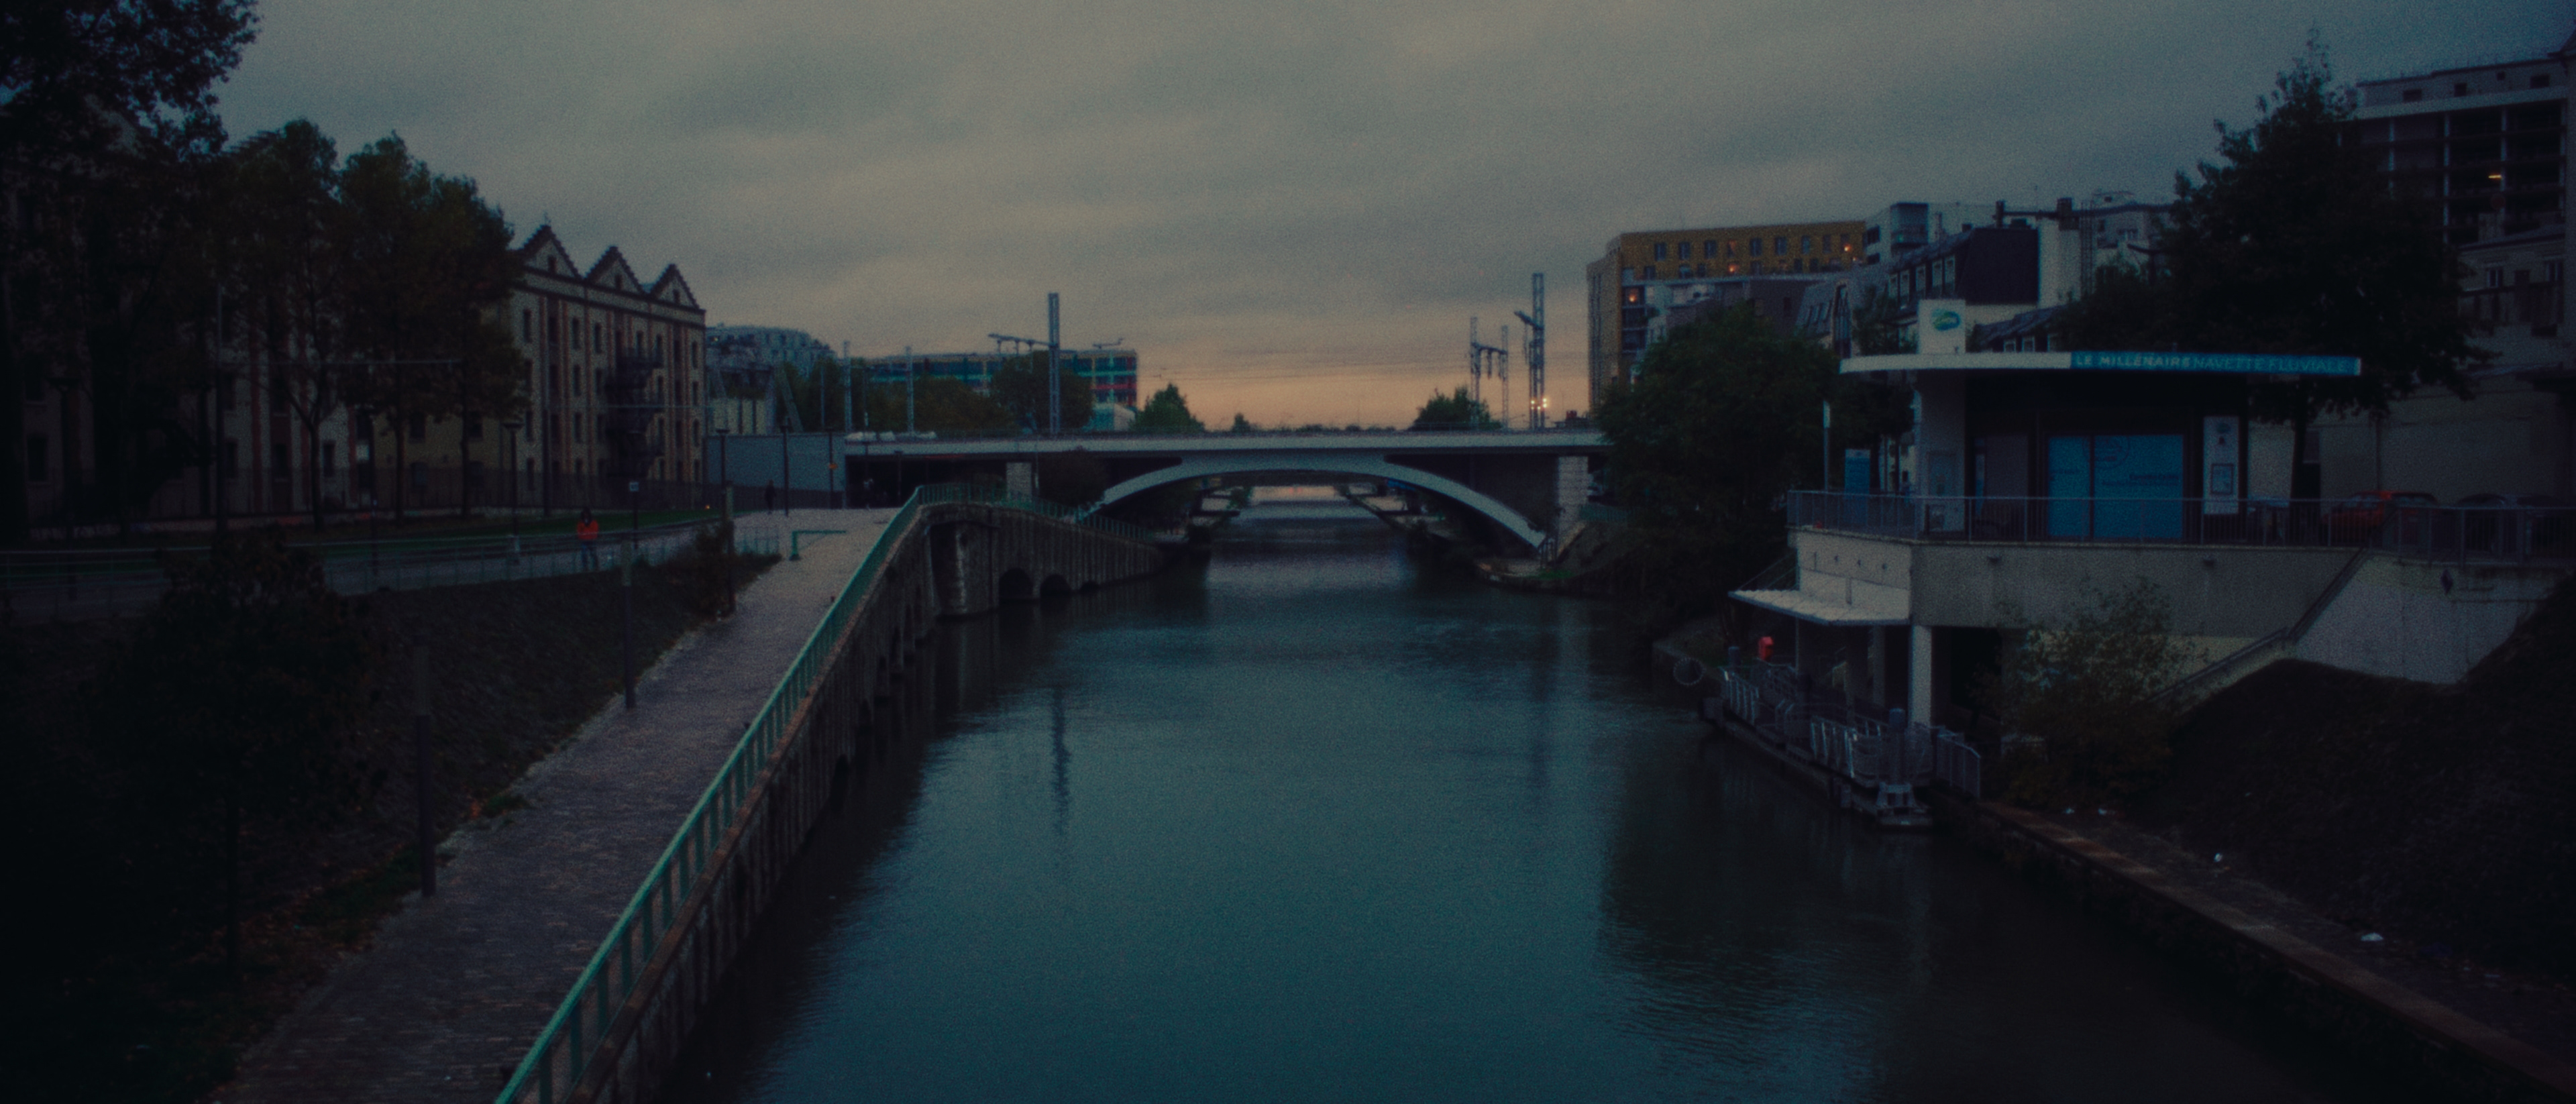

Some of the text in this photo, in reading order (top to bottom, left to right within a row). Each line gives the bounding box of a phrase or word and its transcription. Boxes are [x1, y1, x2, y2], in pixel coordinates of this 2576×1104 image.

[2076, 355, 2092, 366] LE
[2194, 356, 2263, 369] NAVETTE
[2269, 358, 2347, 372] FLUVIALE
